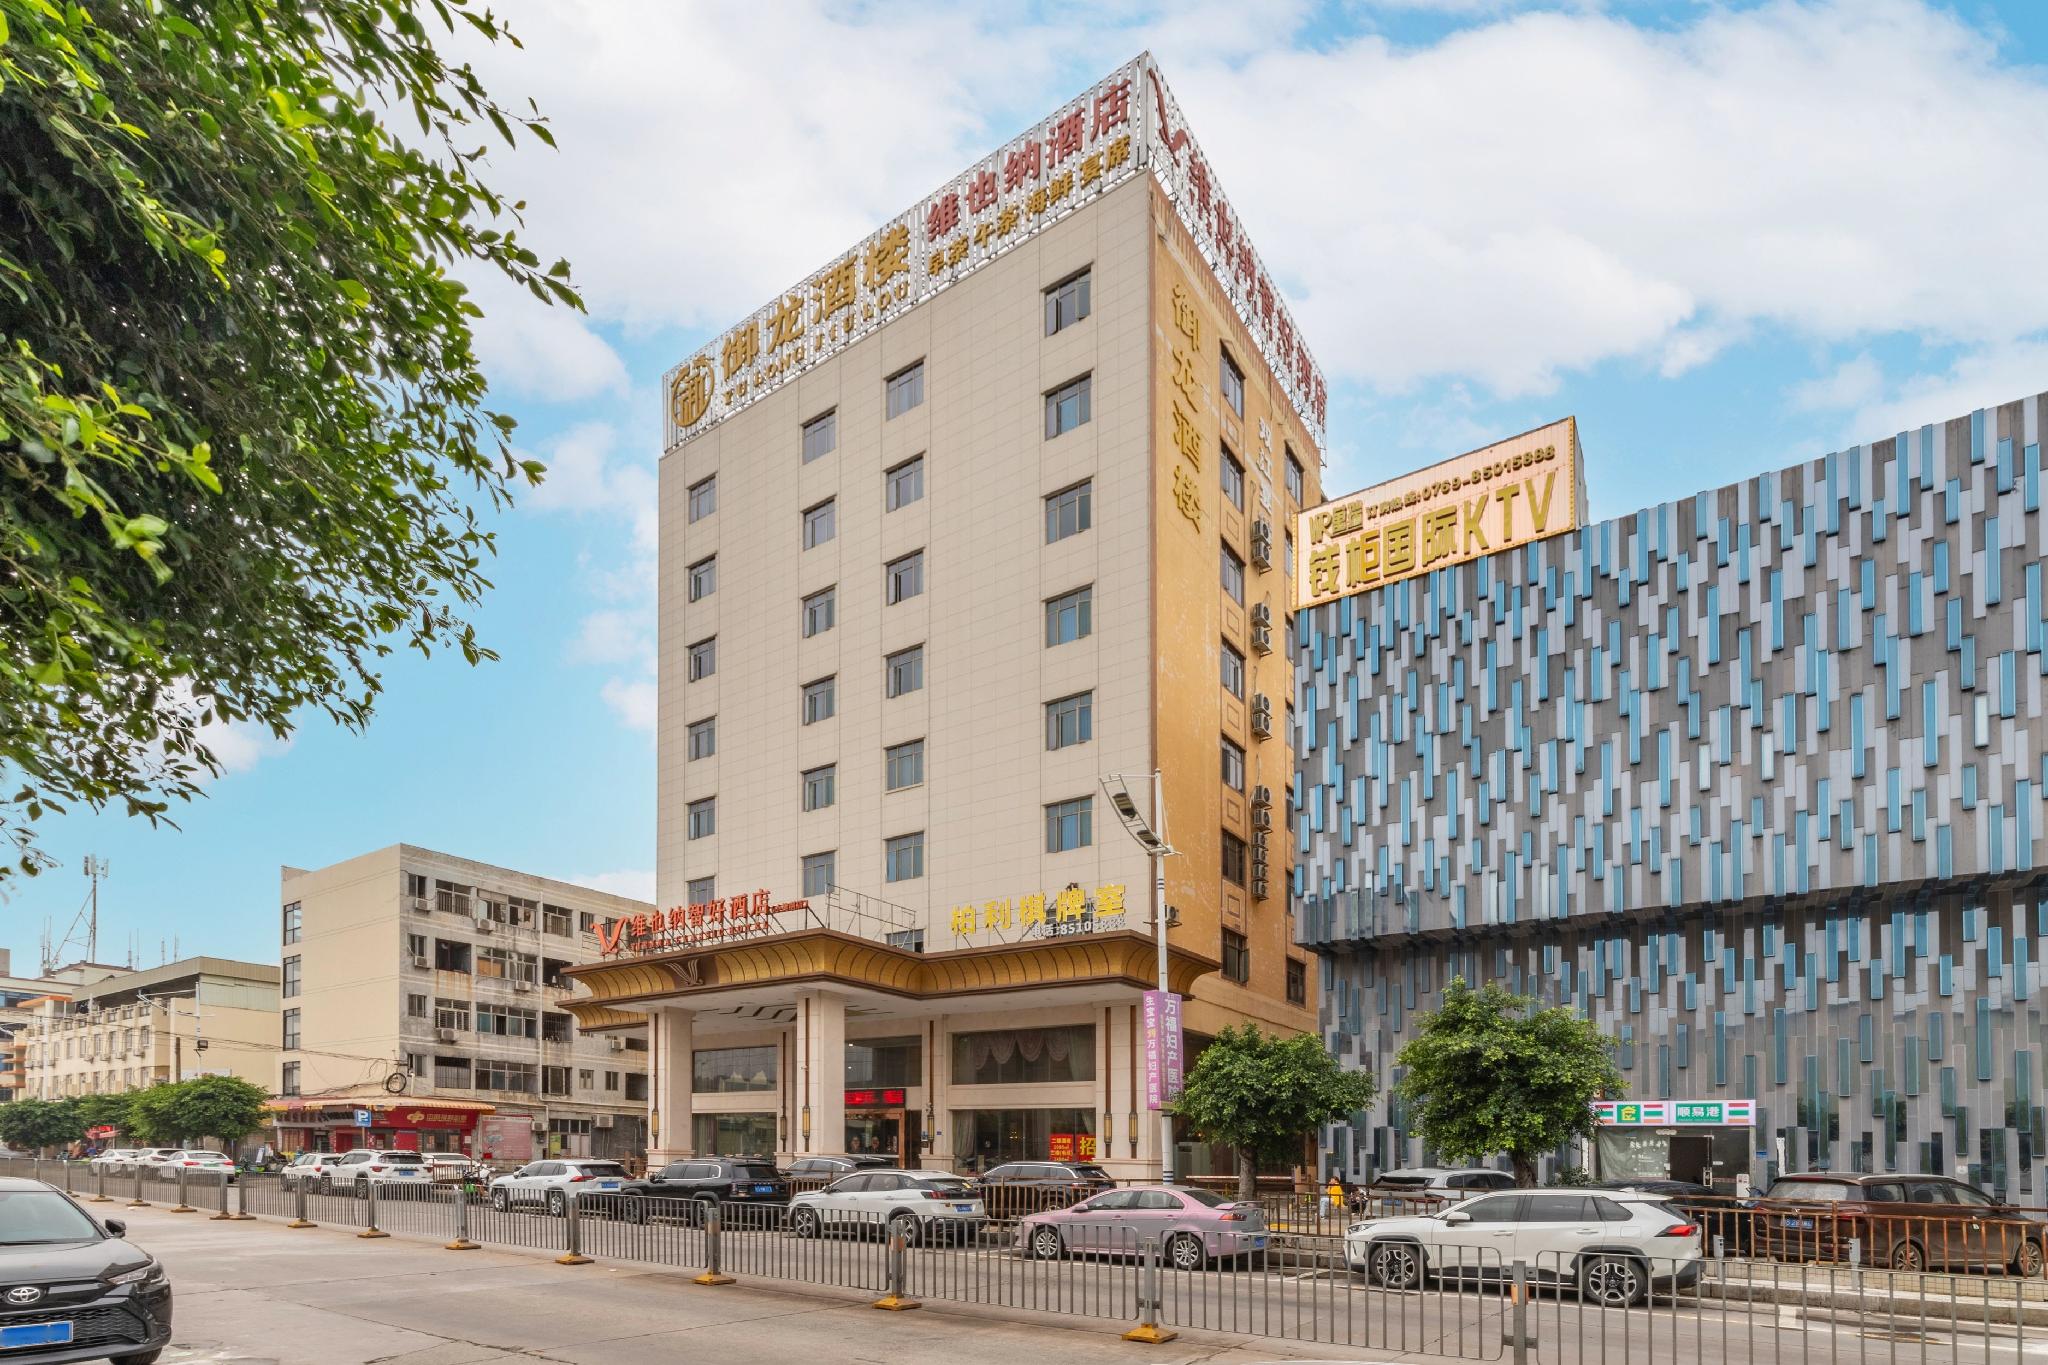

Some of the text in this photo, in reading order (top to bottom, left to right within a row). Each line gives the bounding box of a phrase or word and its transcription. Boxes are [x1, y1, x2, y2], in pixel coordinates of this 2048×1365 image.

[926, 79, 1132, 242] 维也纳酒店
[721, 223, 911, 382] 御龙酒楼
[1309, 471, 1556, 598] 钱柜国际KTV
[630, 888, 771, 938] 维也纳智好酒店
[1677, 1106, 1720, 1118] 顺易港
